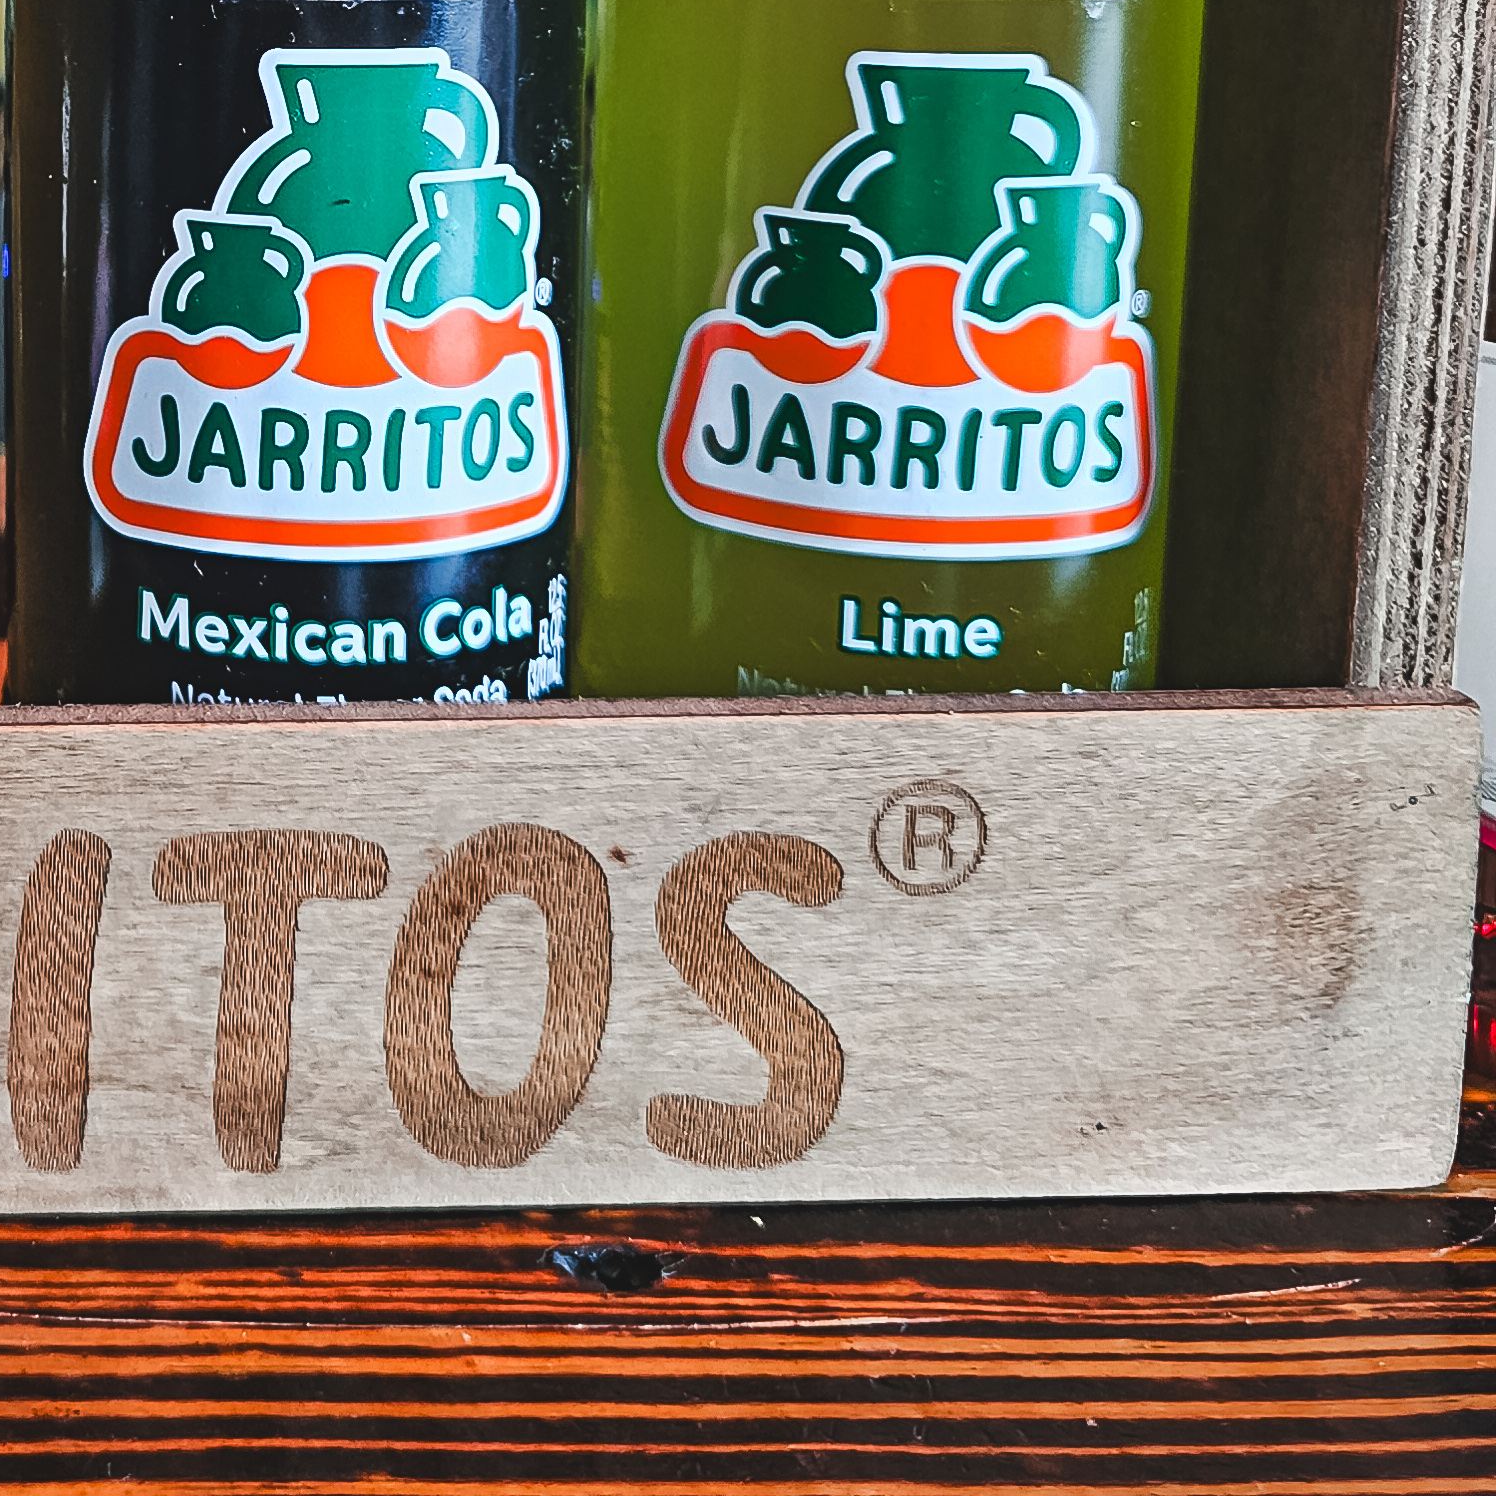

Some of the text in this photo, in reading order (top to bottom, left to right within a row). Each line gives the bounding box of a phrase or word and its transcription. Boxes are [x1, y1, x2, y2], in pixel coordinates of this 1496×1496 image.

[130, 391, 535, 493] JARRITOS
[701, 382, 1125, 492] JARRITOS
[137, 584, 534, 666] Mexican Cola
[839, 596, 1004, 659] Lime
